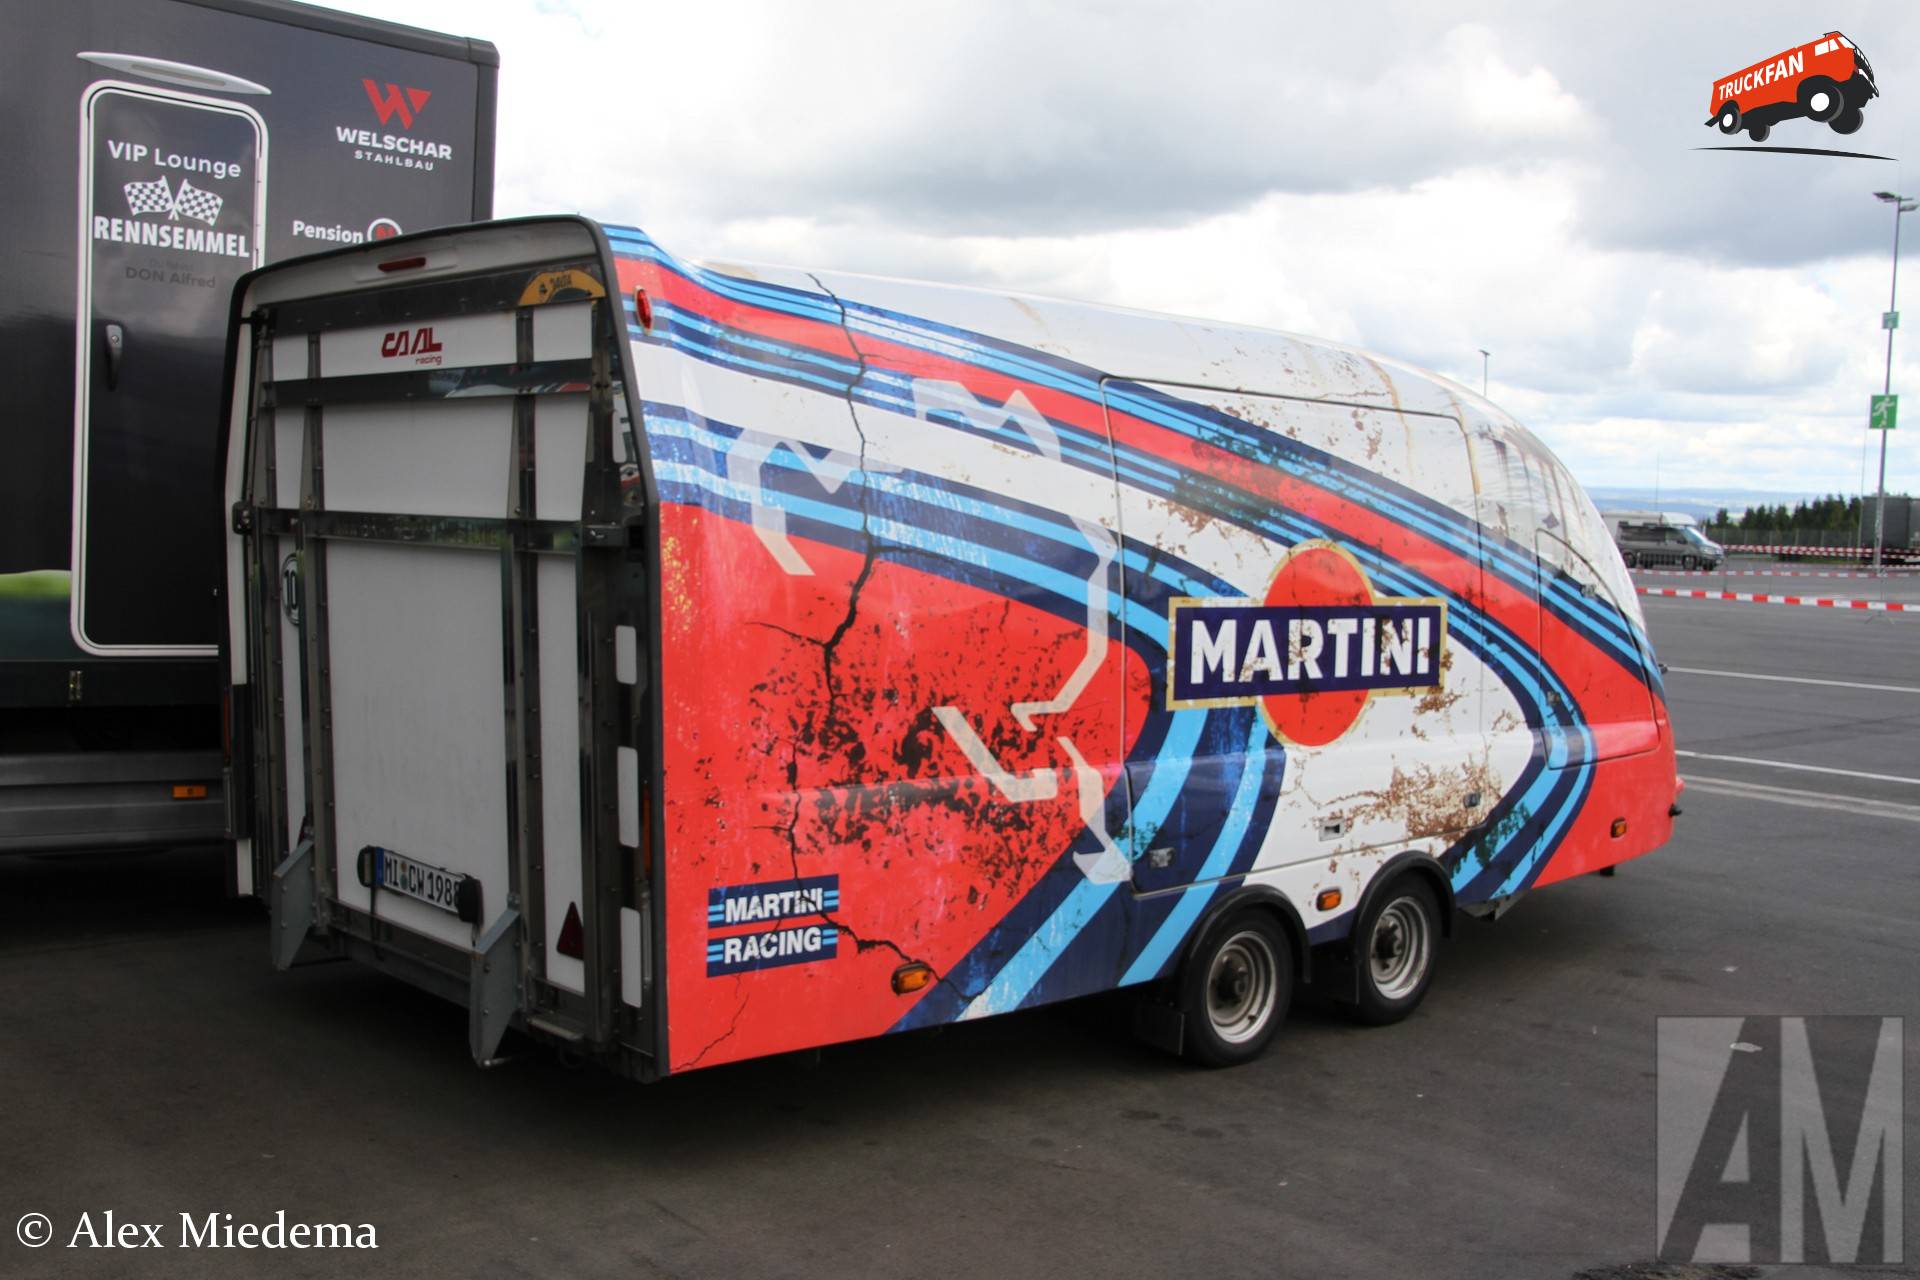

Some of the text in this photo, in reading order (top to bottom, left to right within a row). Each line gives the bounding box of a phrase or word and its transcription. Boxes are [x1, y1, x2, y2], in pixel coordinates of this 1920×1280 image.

[107, 139, 242, 180] VIP Lounge
[335, 126, 453, 161] WELSCHAR
[353, 149, 435, 172] STAHLBAU
[93, 215, 250, 258] RENNSEMMEL
[292, 219, 364, 244] Pension
[125, 266, 216, 289] DON Alfred
[415, 354, 442, 366] racing
[1190, 616, 1431, 685] MARTINI
[725, 887, 823, 923] MARTINI
[724, 926, 822, 964] RACING
